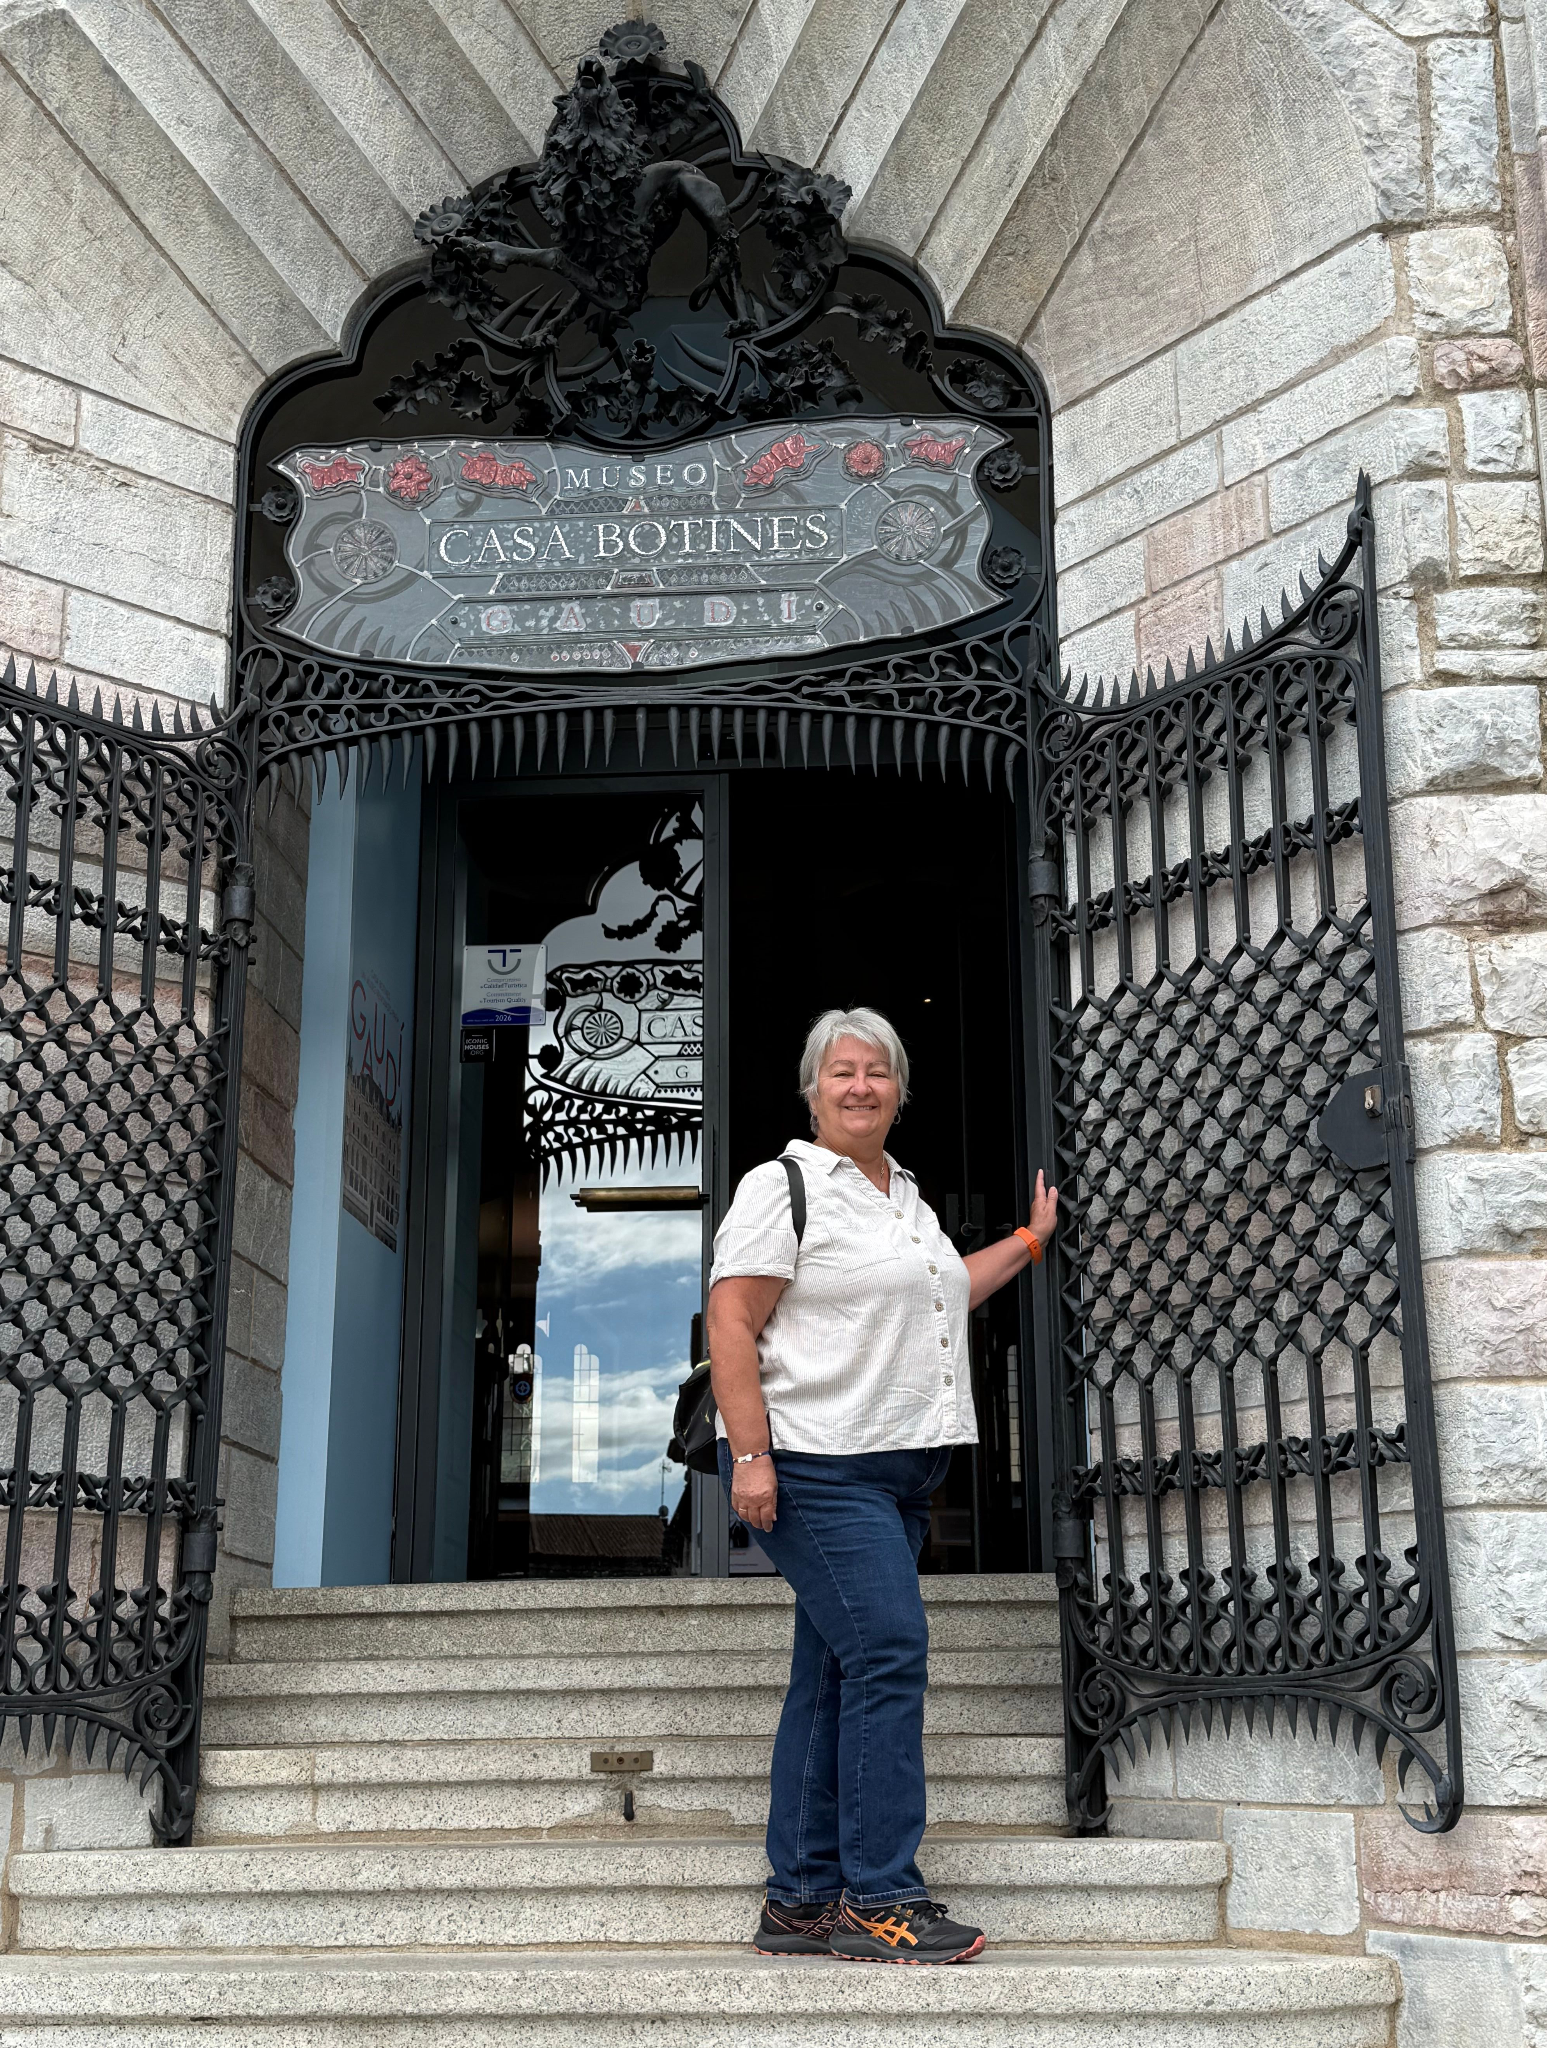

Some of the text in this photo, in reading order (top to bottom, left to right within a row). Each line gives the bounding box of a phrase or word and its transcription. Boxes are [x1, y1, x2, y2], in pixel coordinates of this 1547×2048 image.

[564, 463, 707, 489] MUSEO
[439, 512, 830, 566] CASA BOTINES
[495, 1014, 512, 1022] 2026
